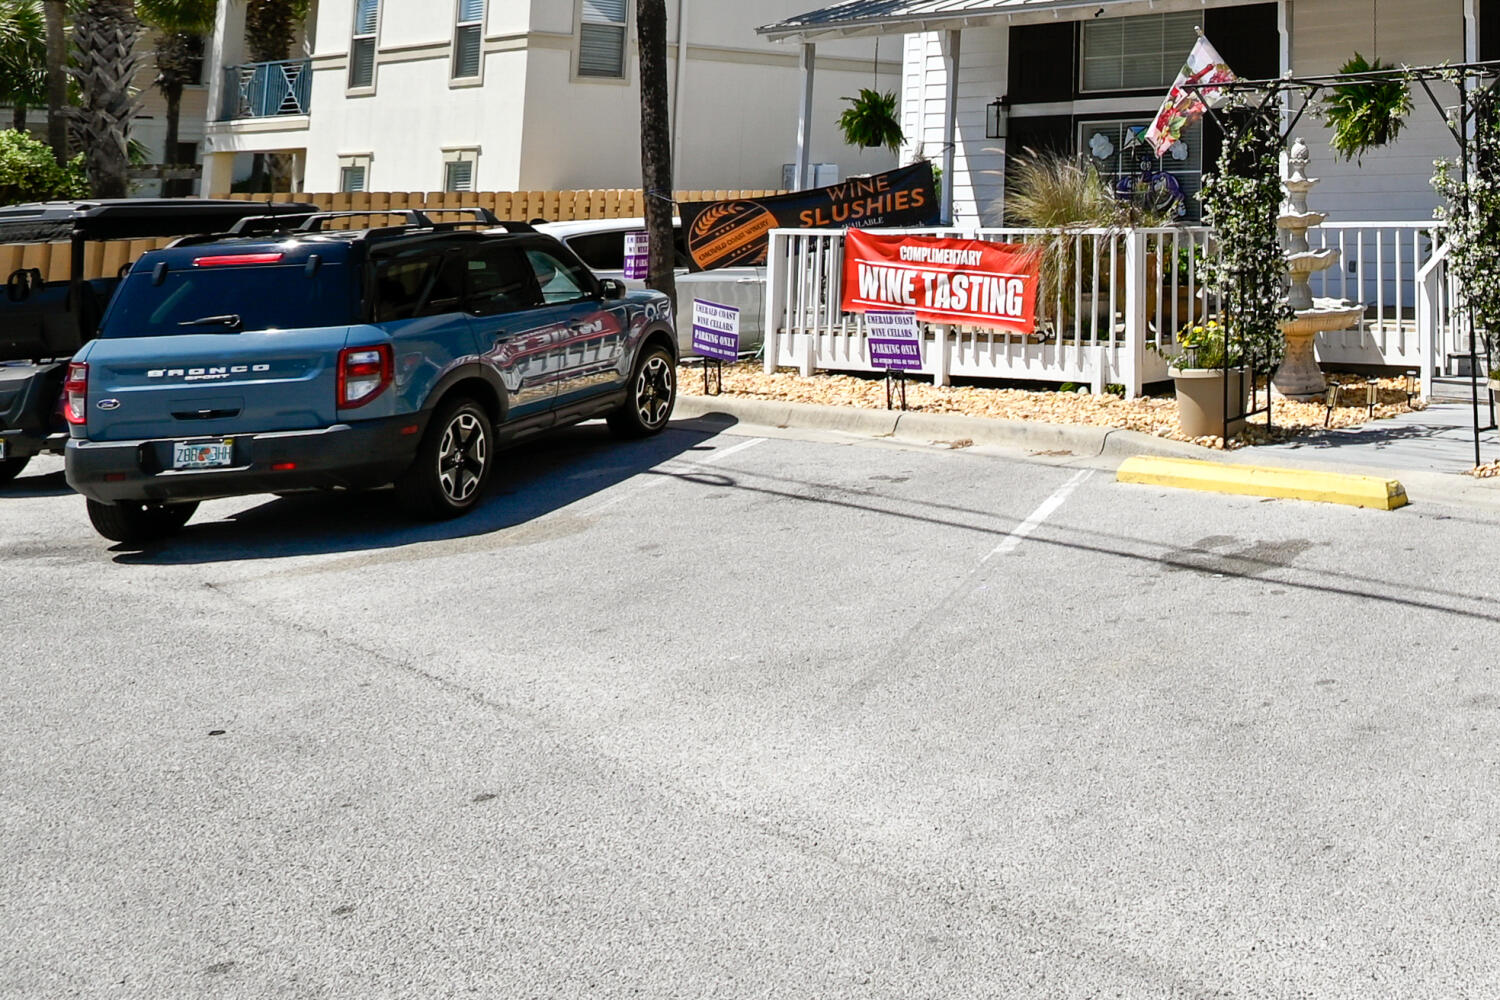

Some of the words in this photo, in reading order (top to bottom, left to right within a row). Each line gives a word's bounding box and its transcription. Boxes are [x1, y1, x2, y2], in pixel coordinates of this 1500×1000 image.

[826, 175, 891, 200] WINE
[799, 188, 926, 228] SLUSHIES
[899, 245, 983, 267] COMPLIMENTARY
[858, 264, 918, 305] WINE
[922, 272, 1023, 316] TASTING
[867, 315, 893, 325] EMERALD
[894, 316, 913, 325] COAST
[871, 328, 886, 337] WINE
[887, 328, 912, 338] CELLARS
[147, 364, 270, 378] BRONCO
[184, 373, 230, 381] SPORT
